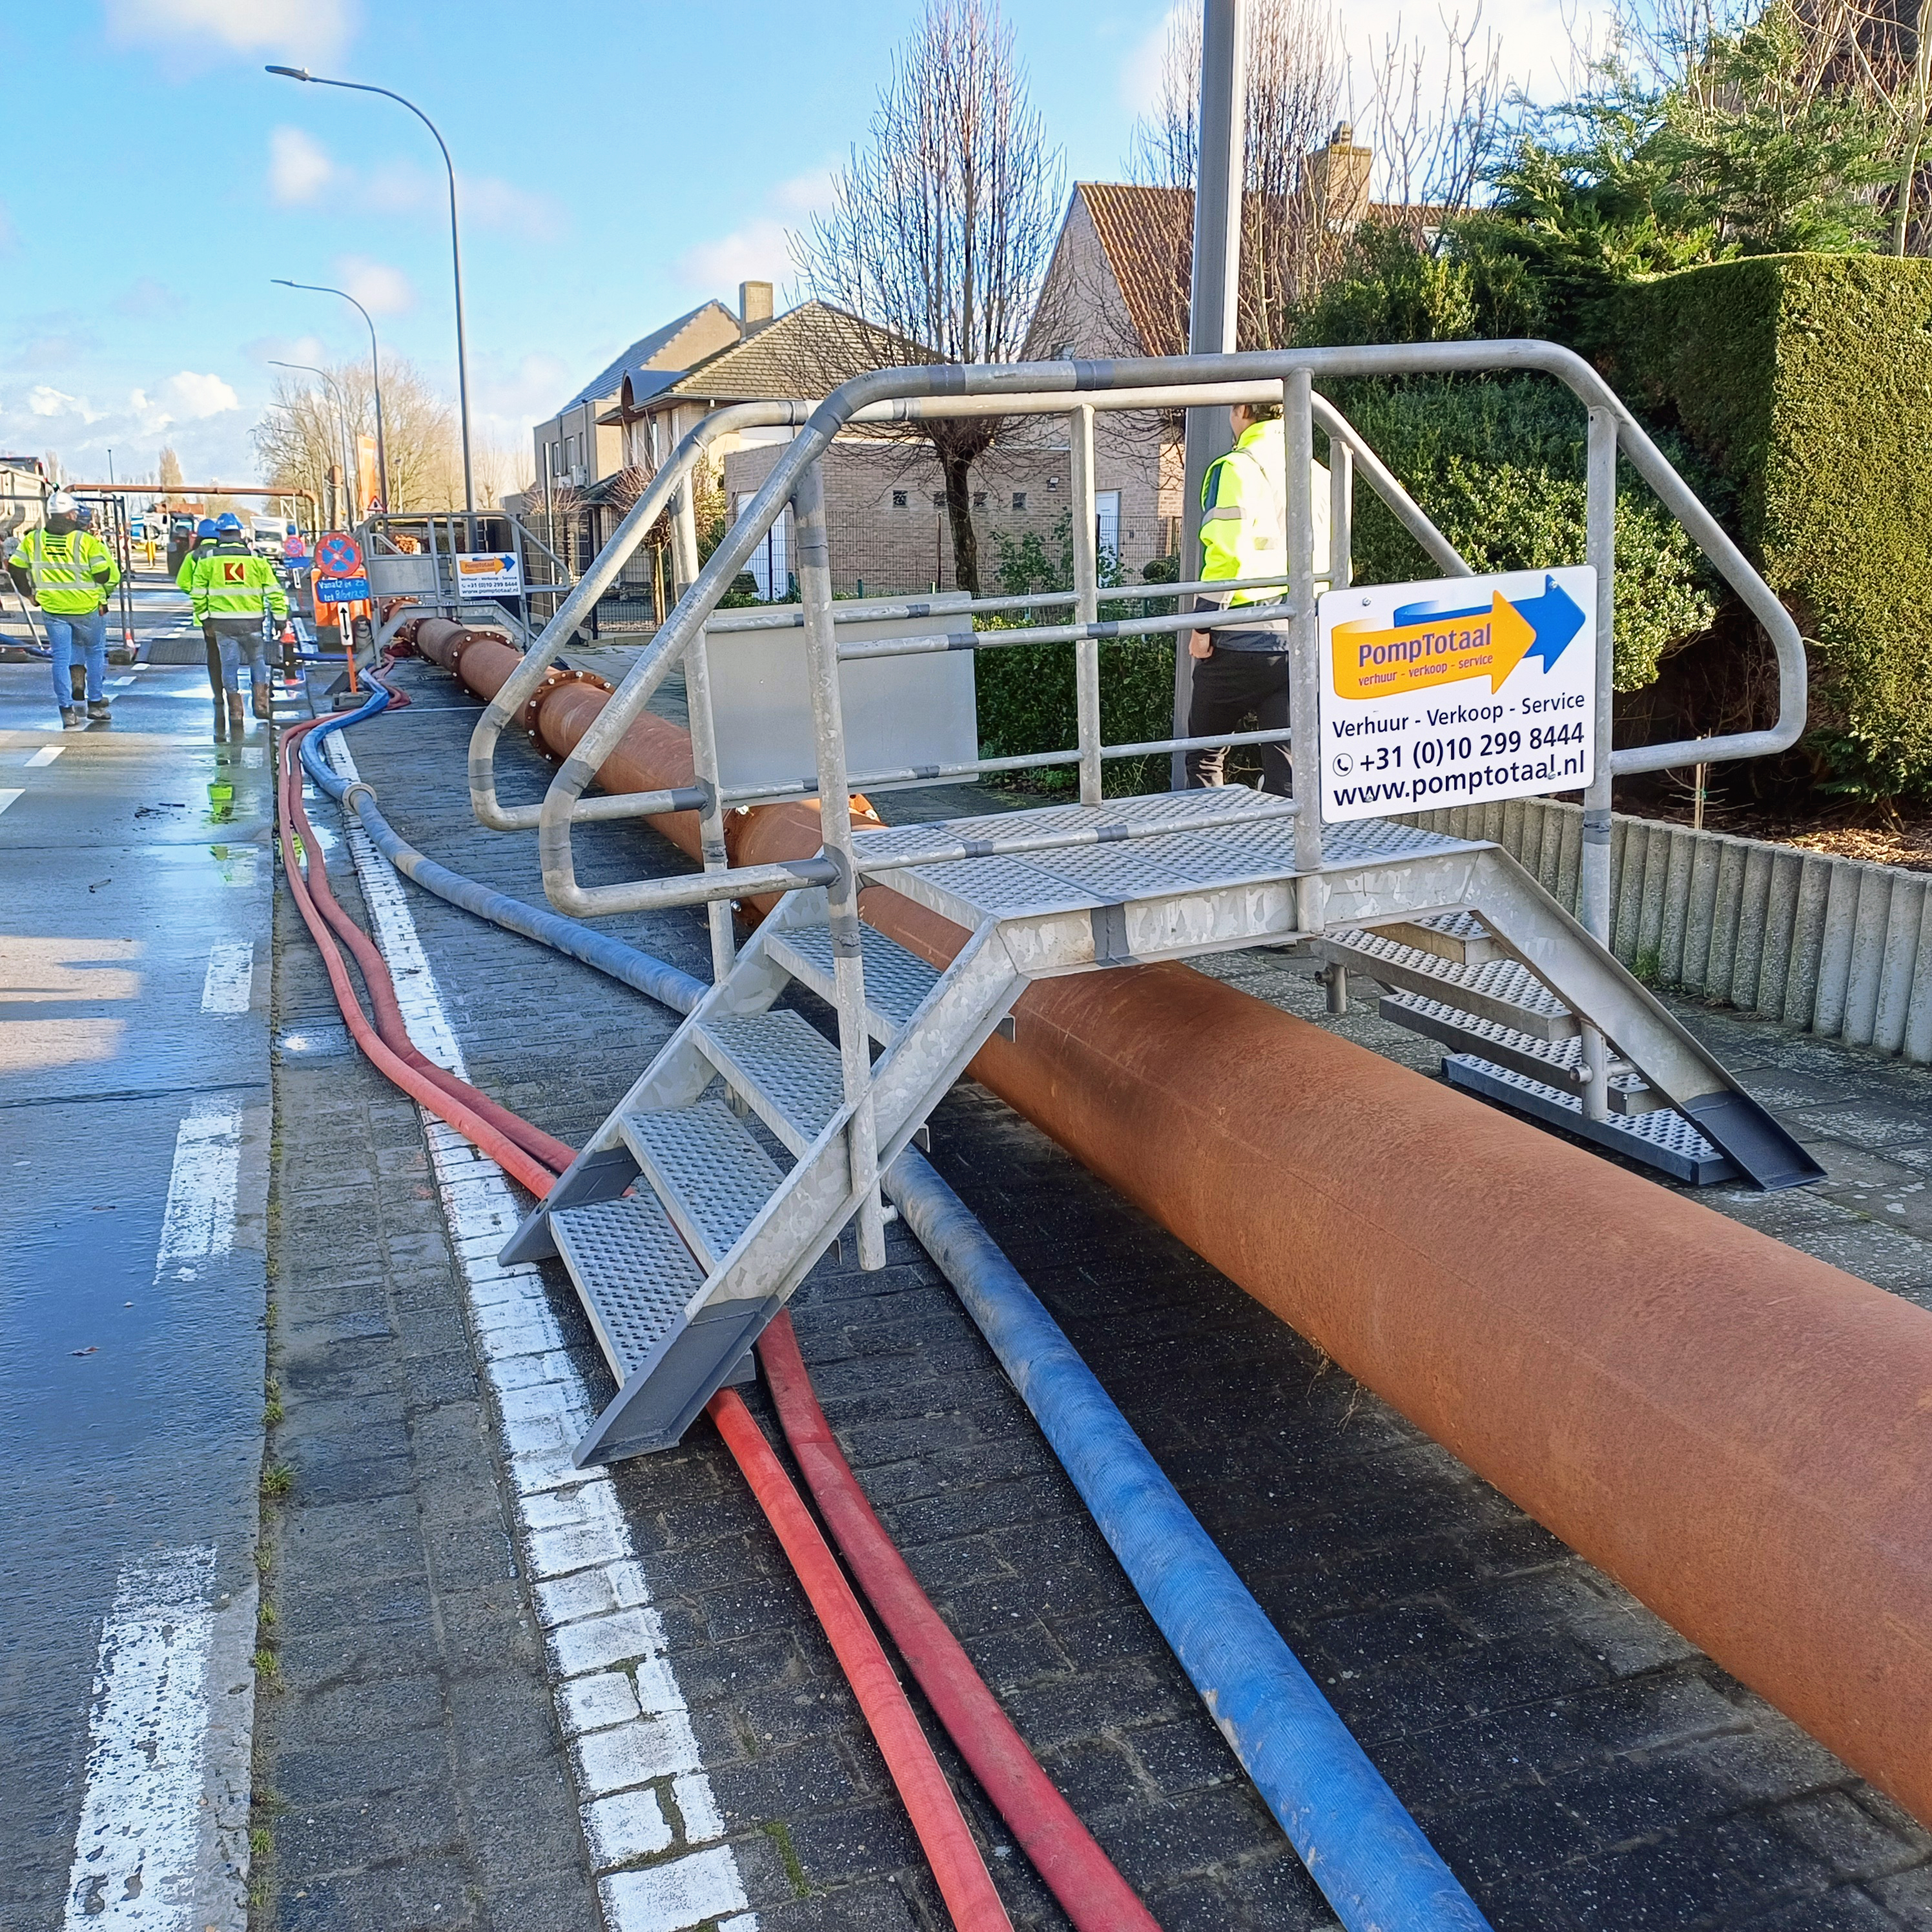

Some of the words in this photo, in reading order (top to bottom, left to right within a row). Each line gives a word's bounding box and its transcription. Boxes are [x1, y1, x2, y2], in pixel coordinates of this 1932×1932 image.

[1359, 622, 1492, 667] PompTotaal
[1359, 671, 1397, 686] verhuur
[1408, 662, 1448, 677] verkoop
[1458, 654, 1493, 669] service
[1332, 716, 1409, 738] Verhuur
[1426, 704, 1503, 726] Verkoop
[1522, 692, 1585, 715] Service
[1360, 747, 1401, 772] +31
[1413, 737, 1472, 769] (0)10
[1480, 730, 1521, 757] 299
[1530, 722, 1585, 750] 8444
[1333, 750, 1584, 807] www.pomptotaal.nl
